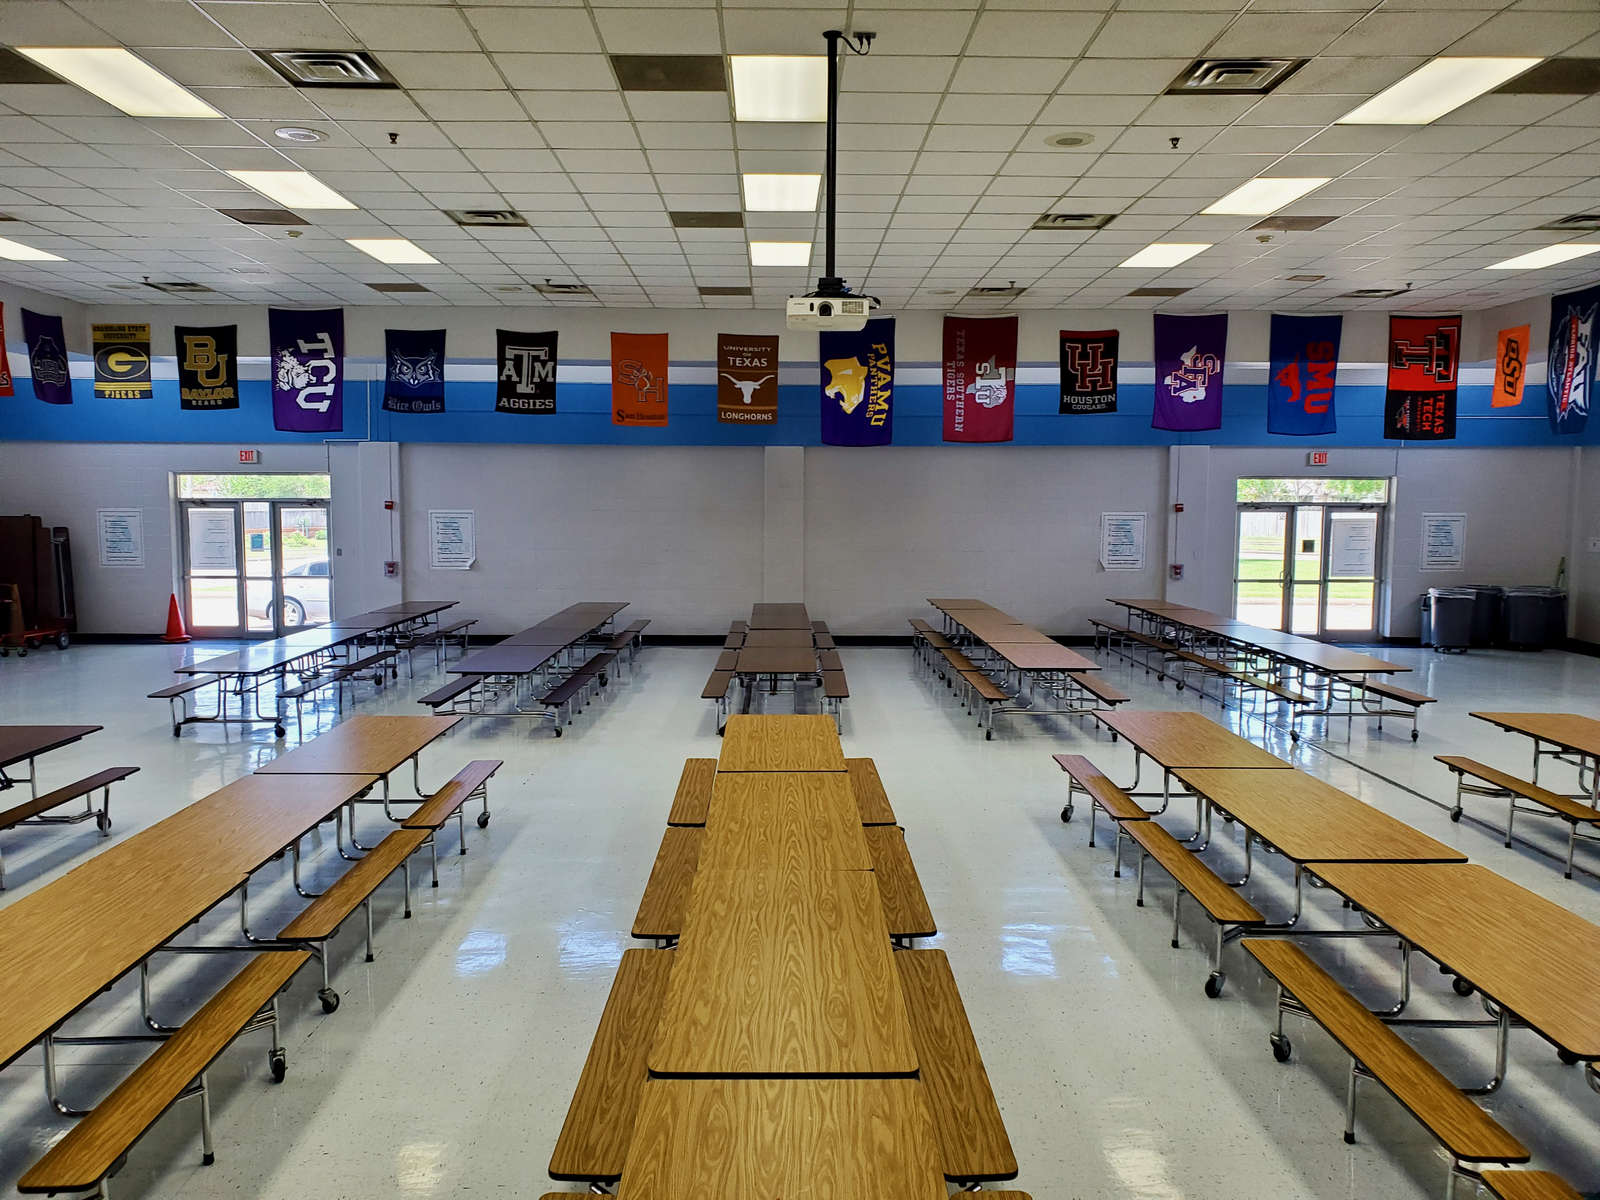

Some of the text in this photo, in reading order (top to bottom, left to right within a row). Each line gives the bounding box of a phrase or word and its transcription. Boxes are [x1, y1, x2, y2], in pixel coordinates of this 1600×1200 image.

[183, 335, 228, 387] BU
[296, 332, 337, 413] TCU
[727, 356, 768, 367] TEXAS
[946, 361, 956, 401] TIGERS
[954, 329, 966, 433] TEXAS SOUTHERN
[1065, 343, 1114, 391] UH
[1170, 353, 1221, 396] SFA
[1303, 341, 1336, 414] SMU
[1502, 337, 1522, 397] OSU
[104, 390, 141, 399] TIGERS
[181, 386, 234, 399] BAYLOR
[412, 399, 440, 411] Owls
[498, 398, 554, 409] AGGIES
[866, 353, 878, 418] PANTHERS
[870, 343, 892, 426] PVAMU
[1063, 393, 1116, 404] HOUSTON
[721, 411, 773, 421] LONGHORNS
[1422, 397, 1434, 431] TECH
[1433, 393, 1445, 434] TEXAS
